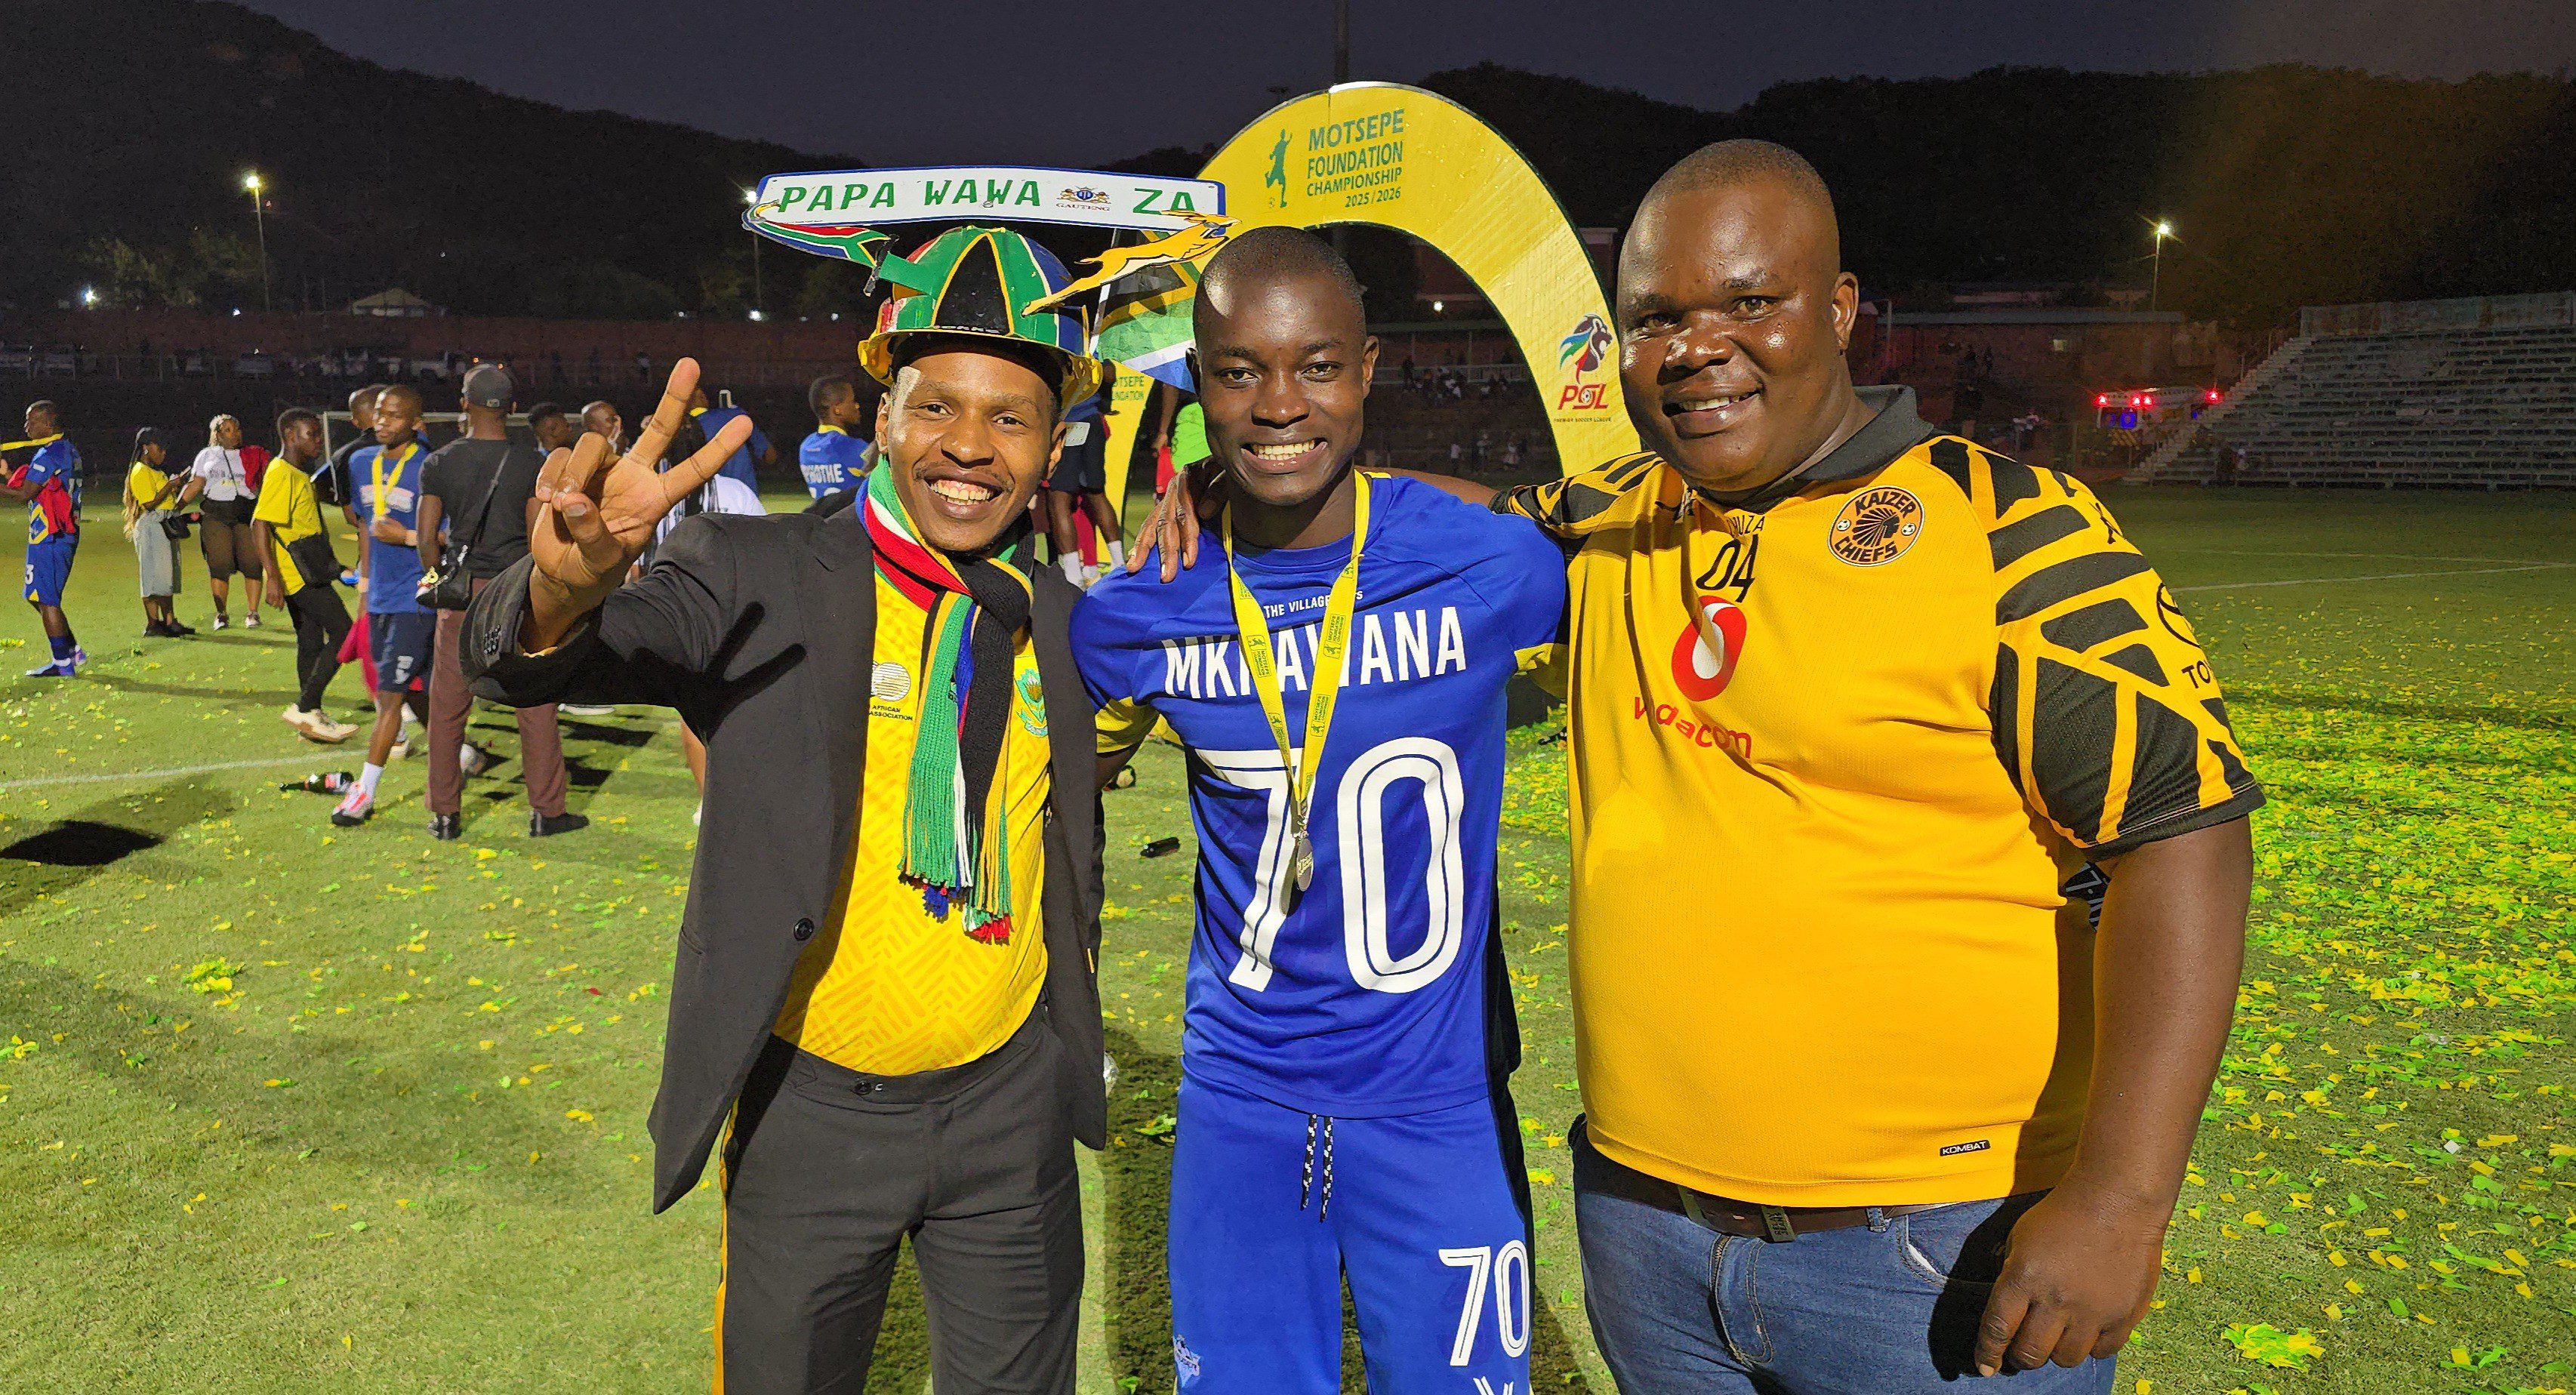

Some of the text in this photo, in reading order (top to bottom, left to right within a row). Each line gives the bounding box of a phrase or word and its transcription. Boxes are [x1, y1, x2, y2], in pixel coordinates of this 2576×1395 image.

[1308, 108, 1405, 151] MOTSEPE
[1307, 140, 1404, 178] FOUNDATION
[778, 179, 1196, 215] PAPA WAWA ZA
[1306, 167, 1402, 196] CHAMPIONSHIP
[1854, 491, 1916, 519] KAIZER
[1834, 536, 1898, 562] CHIEFS
[1695, 533, 1759, 603] 04
[1263, 604, 1285, 619] THE
[1161, 606, 1467, 699] MKAANA
[1194, 736, 1465, 993] 70
[1942, 1141, 1987, 1155] KOMBAT
[1438, 1239, 1531, 1366] 70
